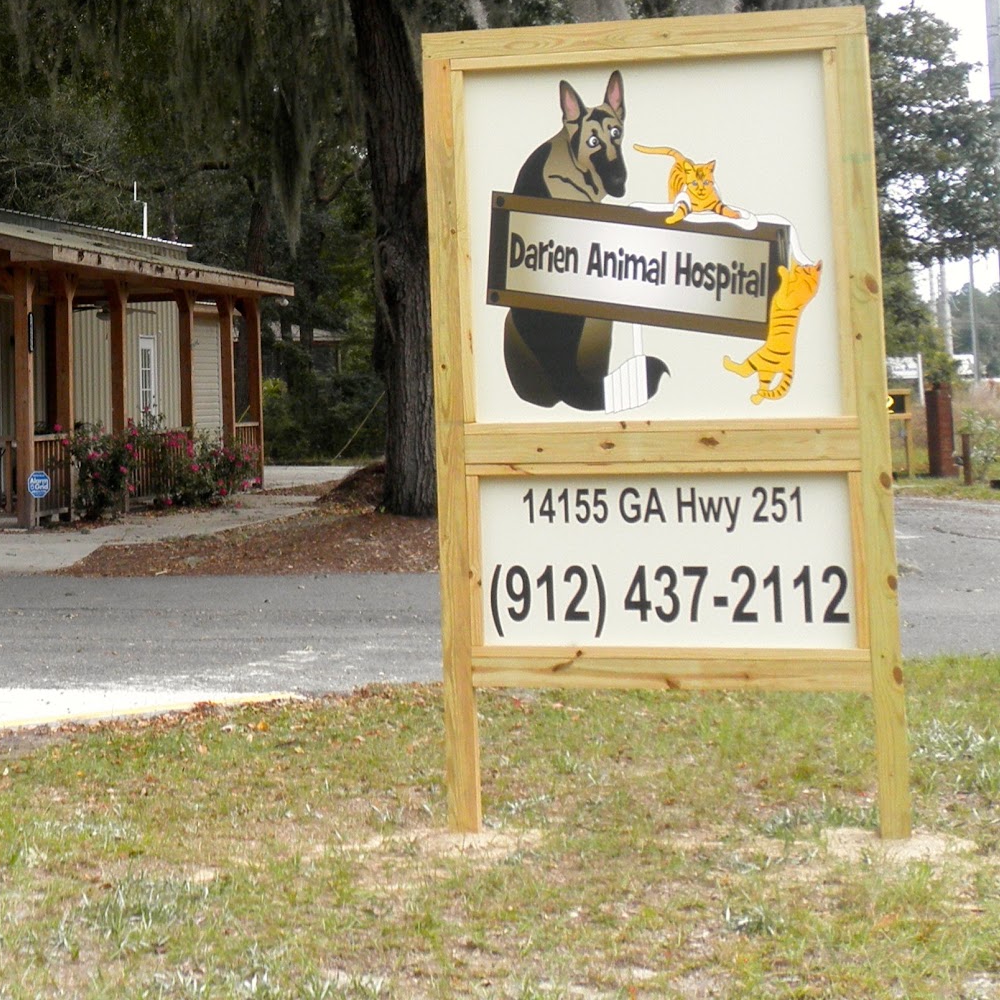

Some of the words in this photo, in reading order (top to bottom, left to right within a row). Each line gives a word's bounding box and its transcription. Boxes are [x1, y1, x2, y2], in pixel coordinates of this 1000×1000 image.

[509, 232, 579, 273] Darien
[586, 242, 667, 285] Animal
[675, 251, 767, 301] Hospital
[522, 488, 609, 524] 14155
[618, 487, 667, 524] GA
[676, 487, 741, 533] Hwy
[752, 486, 804, 524] 251
[490, 564, 607, 639] (912)
[624, 565, 850, 623] 437-2112
